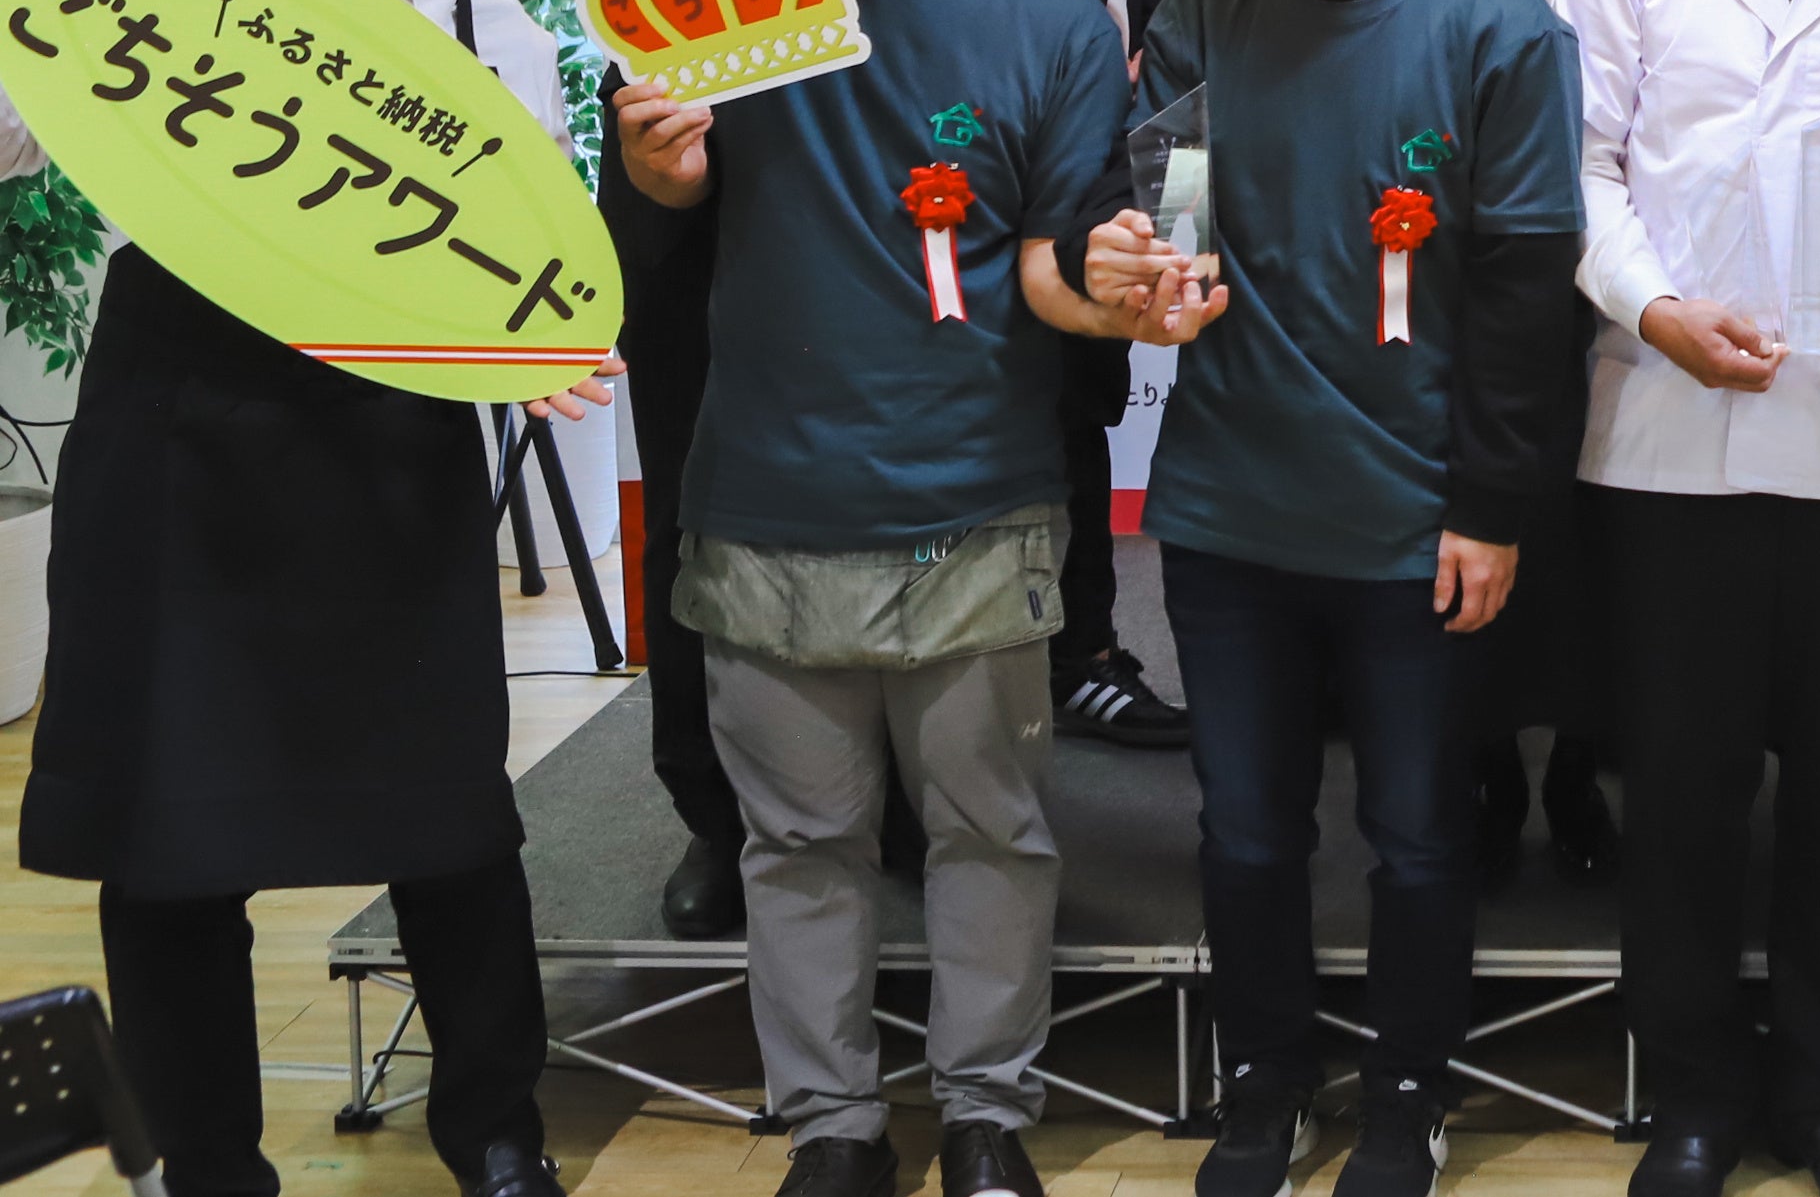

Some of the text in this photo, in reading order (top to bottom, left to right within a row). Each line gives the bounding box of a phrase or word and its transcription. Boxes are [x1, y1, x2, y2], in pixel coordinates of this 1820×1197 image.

[238, 7, 470, 157] ふるさと納税
